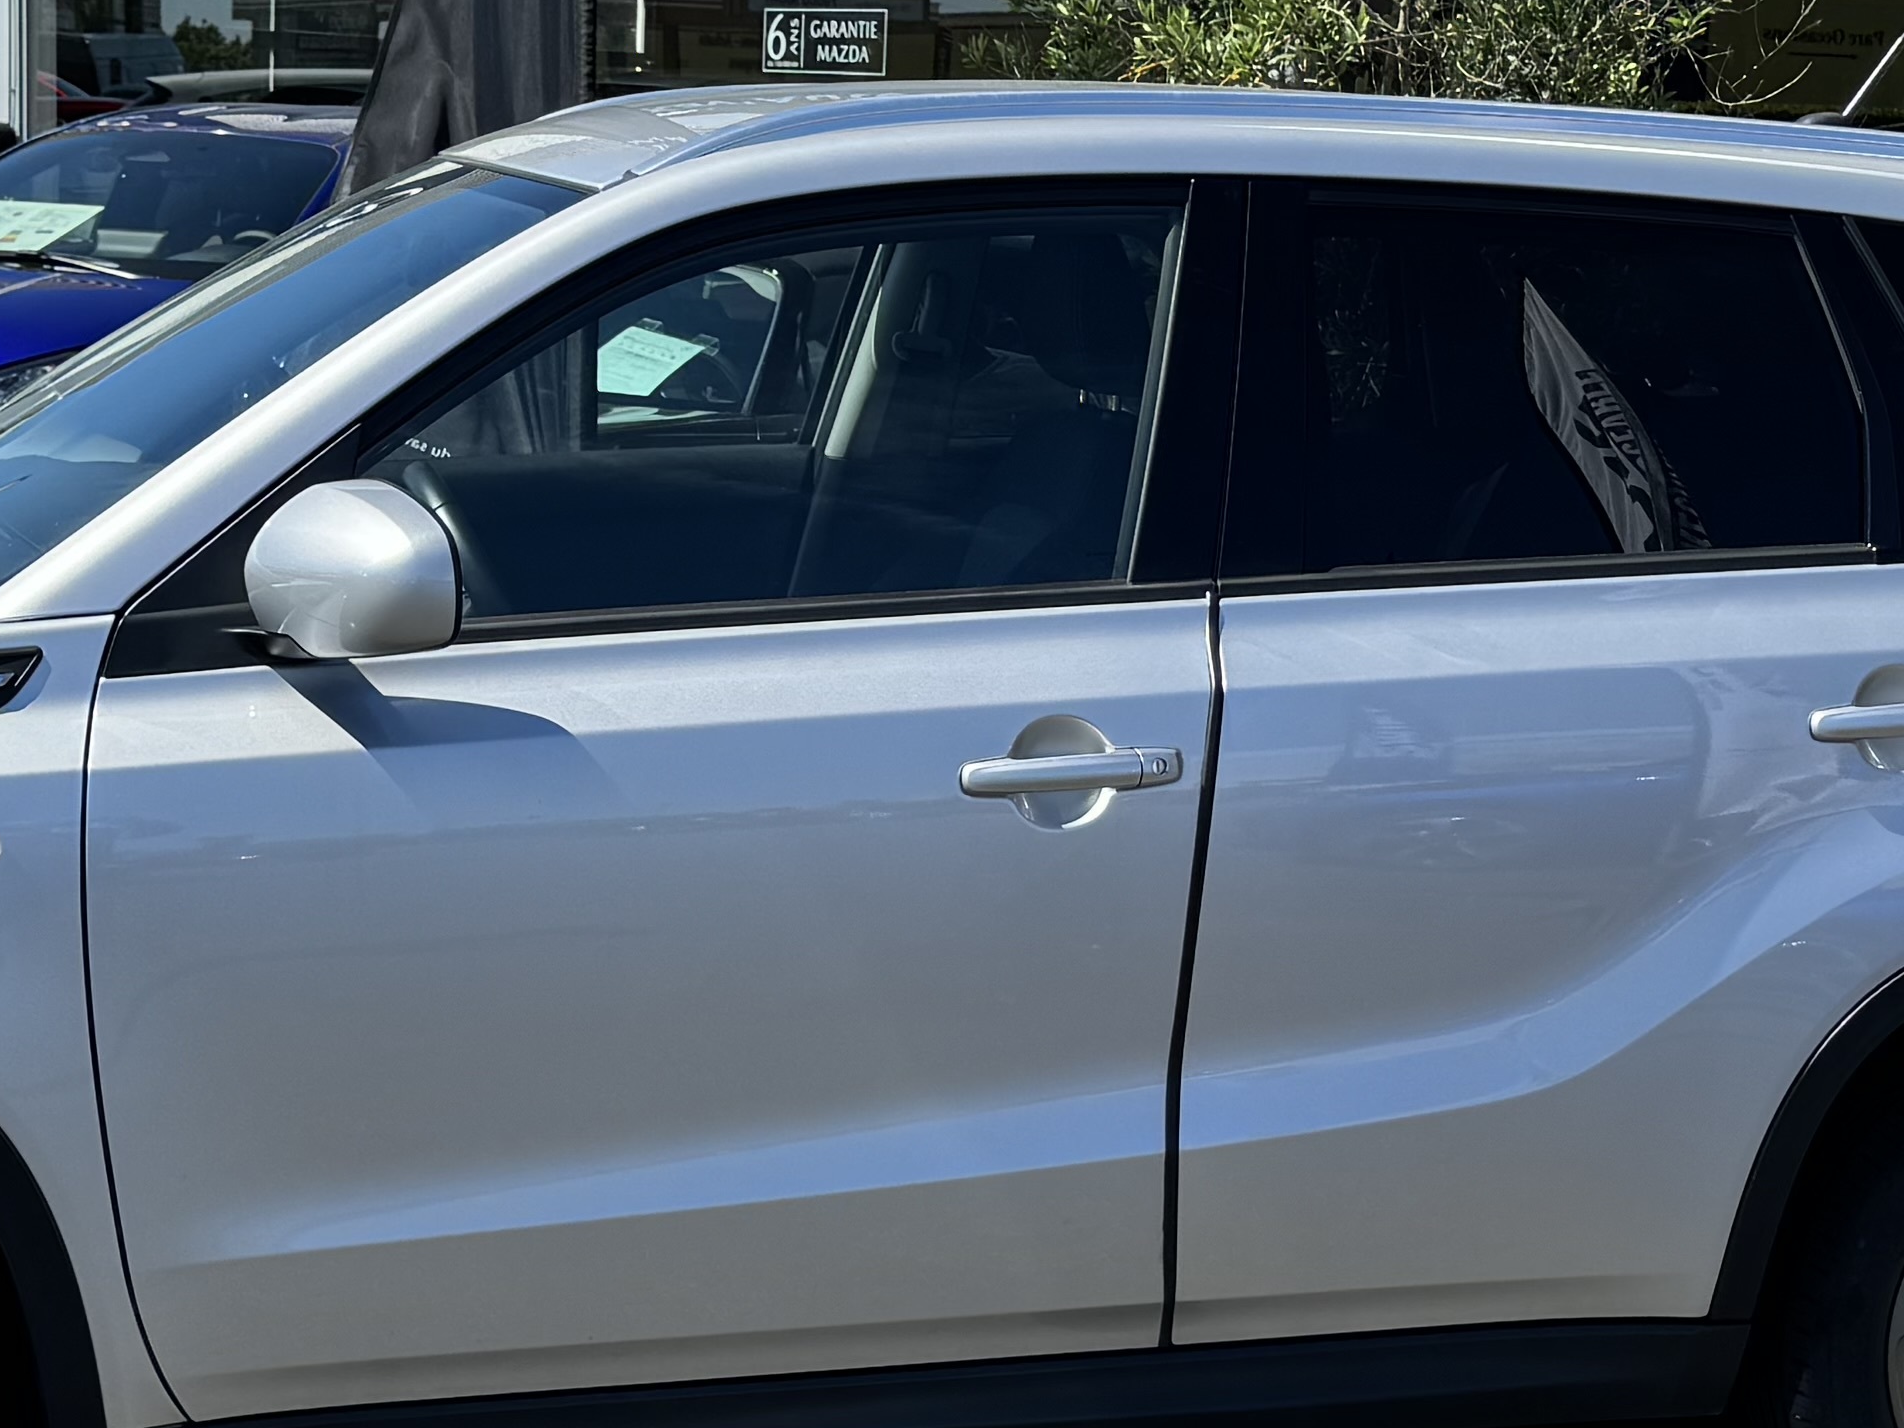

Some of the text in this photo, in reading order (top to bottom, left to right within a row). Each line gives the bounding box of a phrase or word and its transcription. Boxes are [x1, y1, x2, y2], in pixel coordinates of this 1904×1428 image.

[767, 13, 787, 61] 6
[789, 18, 800, 56] ANS
[810, 20, 879, 40] GARANTIE
[816, 44, 870, 64] MAZDA
